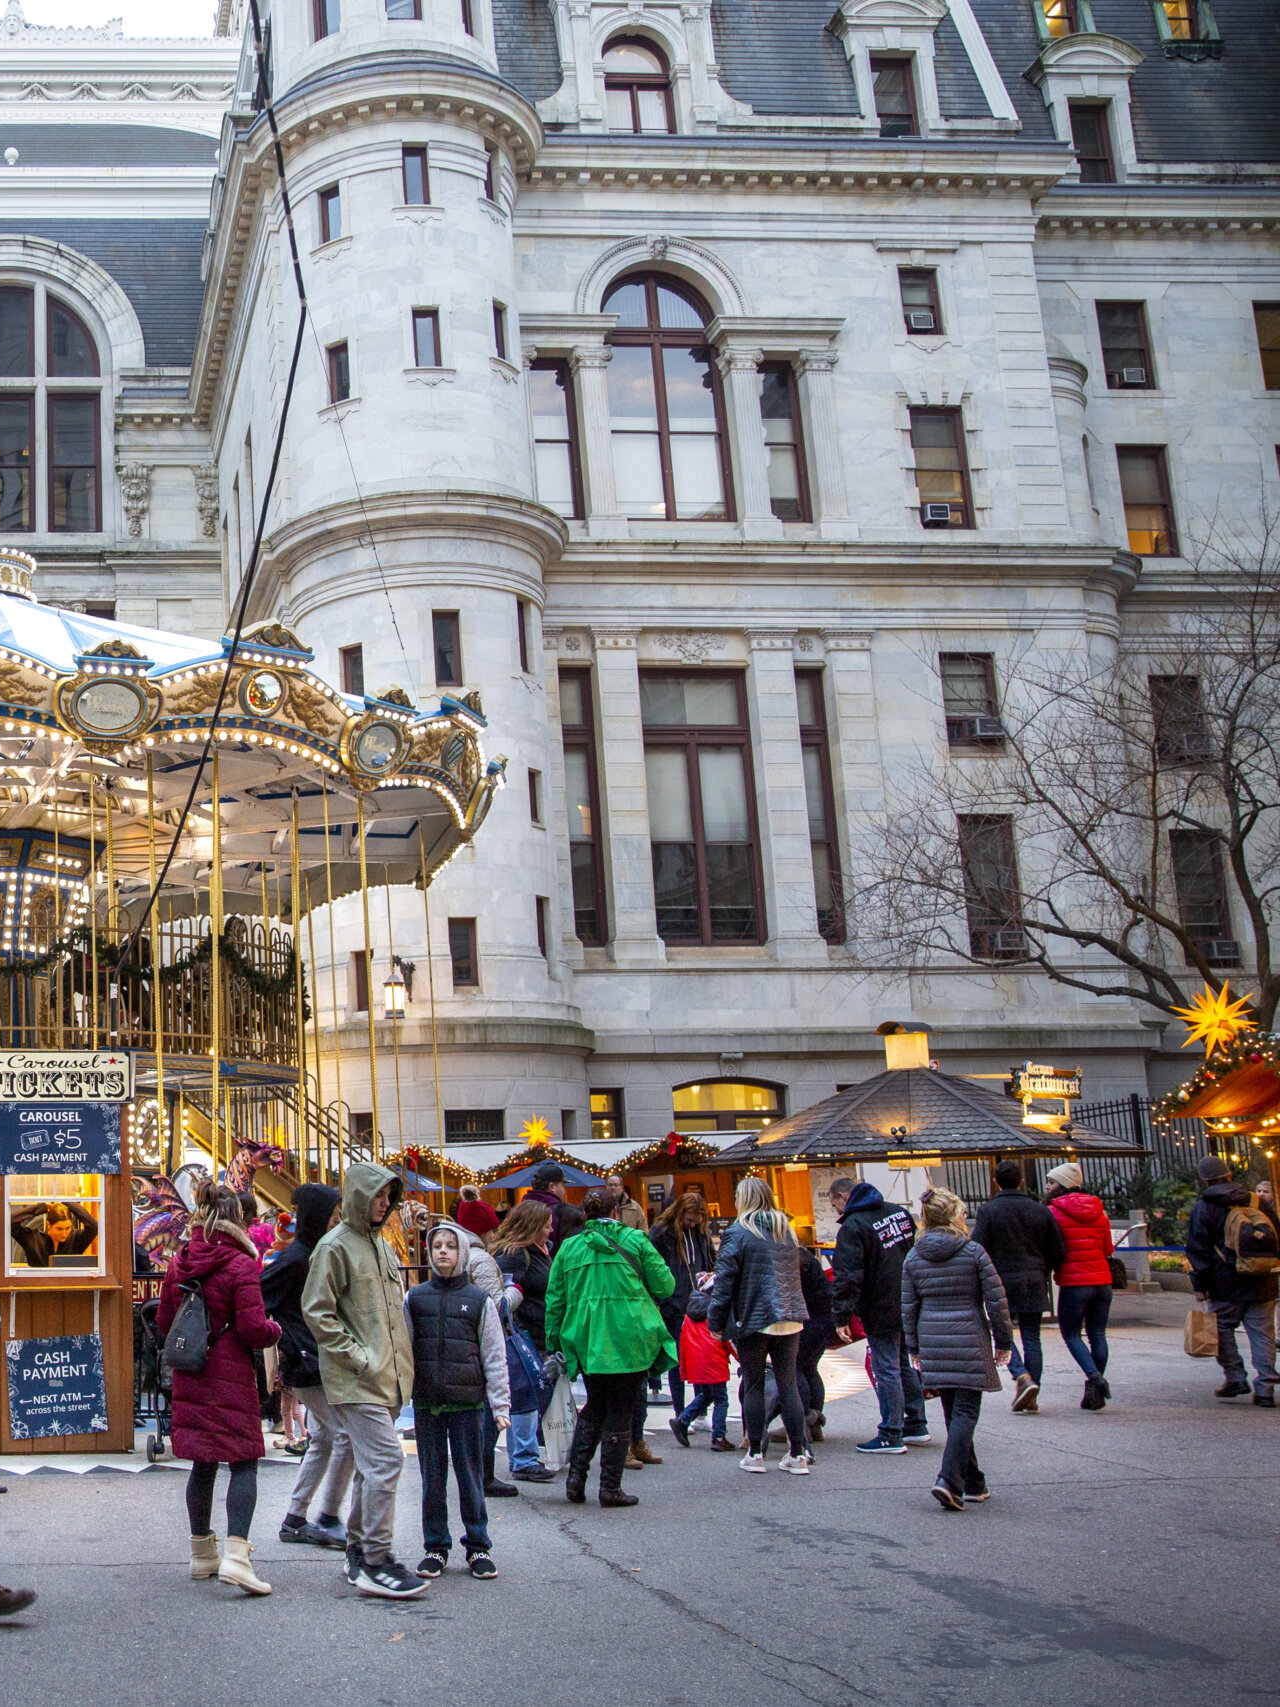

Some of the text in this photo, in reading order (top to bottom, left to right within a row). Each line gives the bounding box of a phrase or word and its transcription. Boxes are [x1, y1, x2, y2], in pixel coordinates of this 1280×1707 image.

[7, 1054, 100, 1069] Carousel
[1024, 1060, 1054, 1076] German
[1017, 1071, 1081, 1096] Bratwurst
[19, 1111, 82, 1122] CAROUSEL
[53, 1129, 82, 1149] $5
[13, 1152, 88, 1162] CASH PAYMENT
[872, 1211, 907, 1231] CLAYTON
[34, 1351, 70, 1365] CASH
[23, 1364, 88, 1380] PAYMENT
[33, 1392, 82, 1404] NEXT ATM
[26, 1403, 91, 1415] across the street
